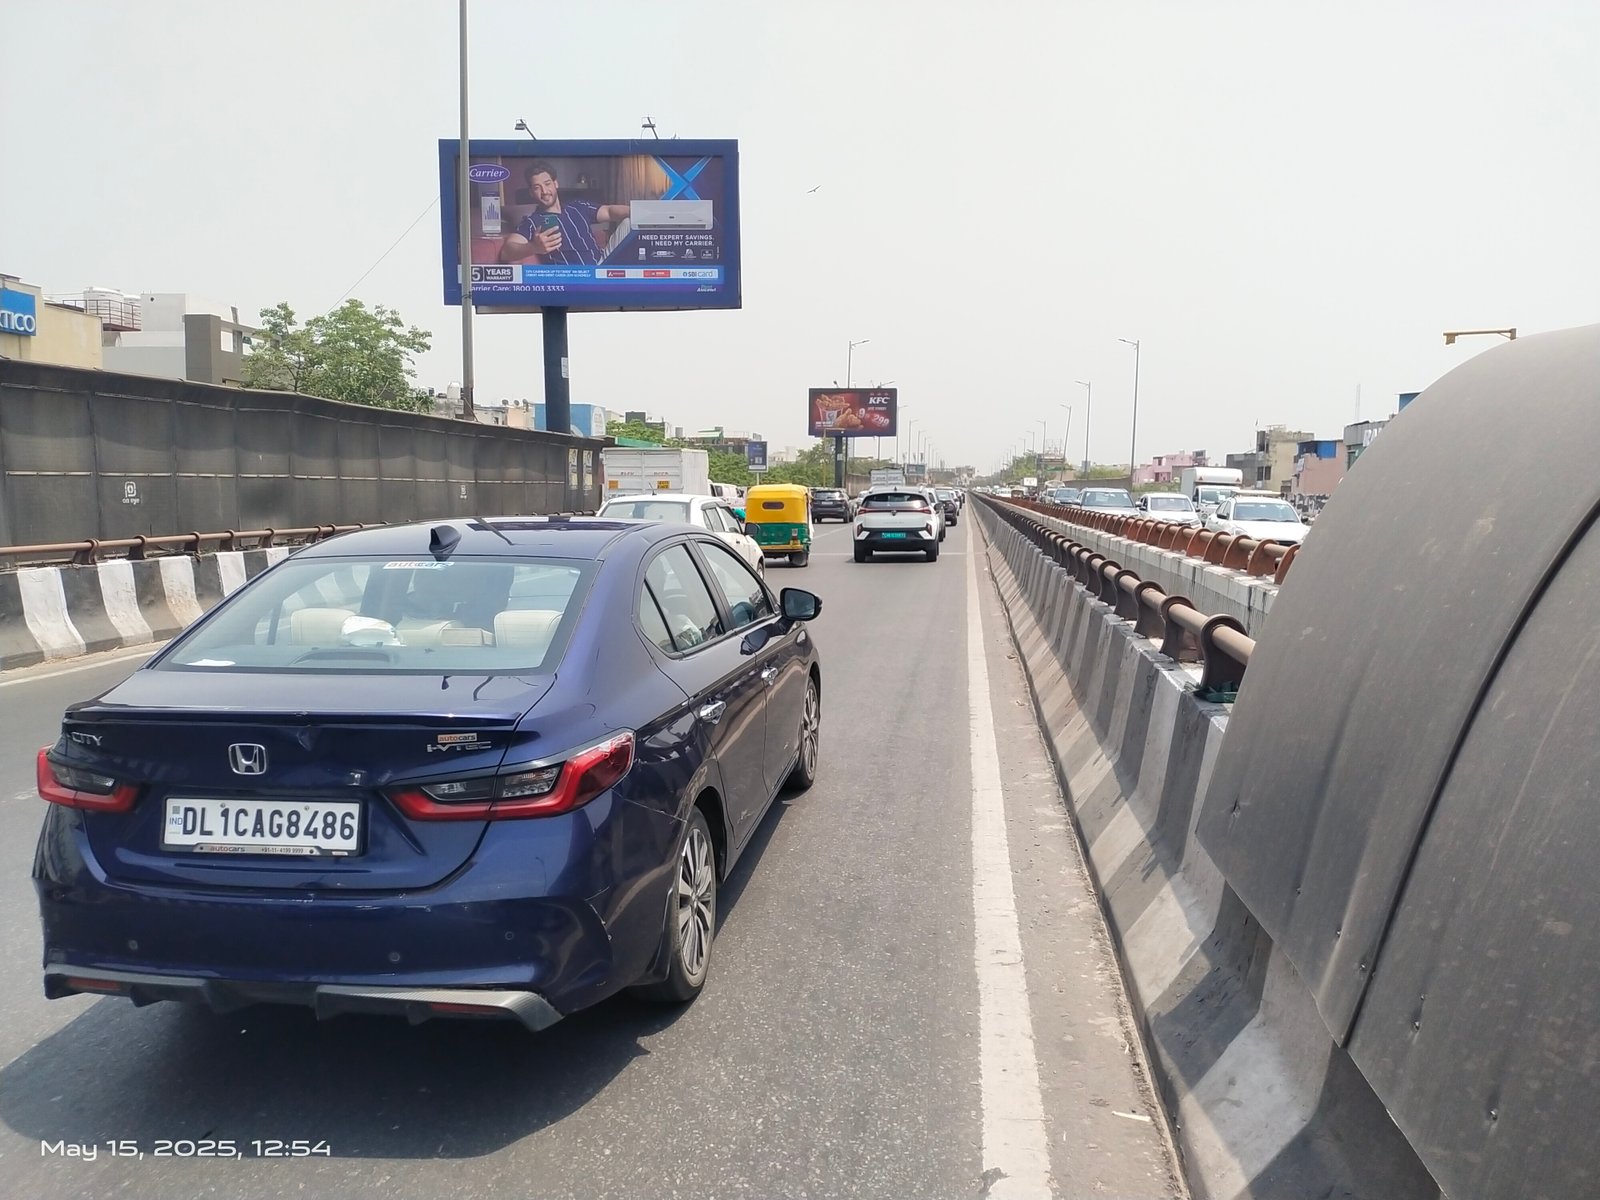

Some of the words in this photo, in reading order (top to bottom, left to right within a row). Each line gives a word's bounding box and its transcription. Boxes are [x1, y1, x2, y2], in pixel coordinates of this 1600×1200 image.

[470, 168, 504, 177] Carrier
[472, 268, 480, 280] 5
[868, 396, 890, 404] KFC
[71, 732, 103, 746] CITY
[169, 817, 183, 826] IND
